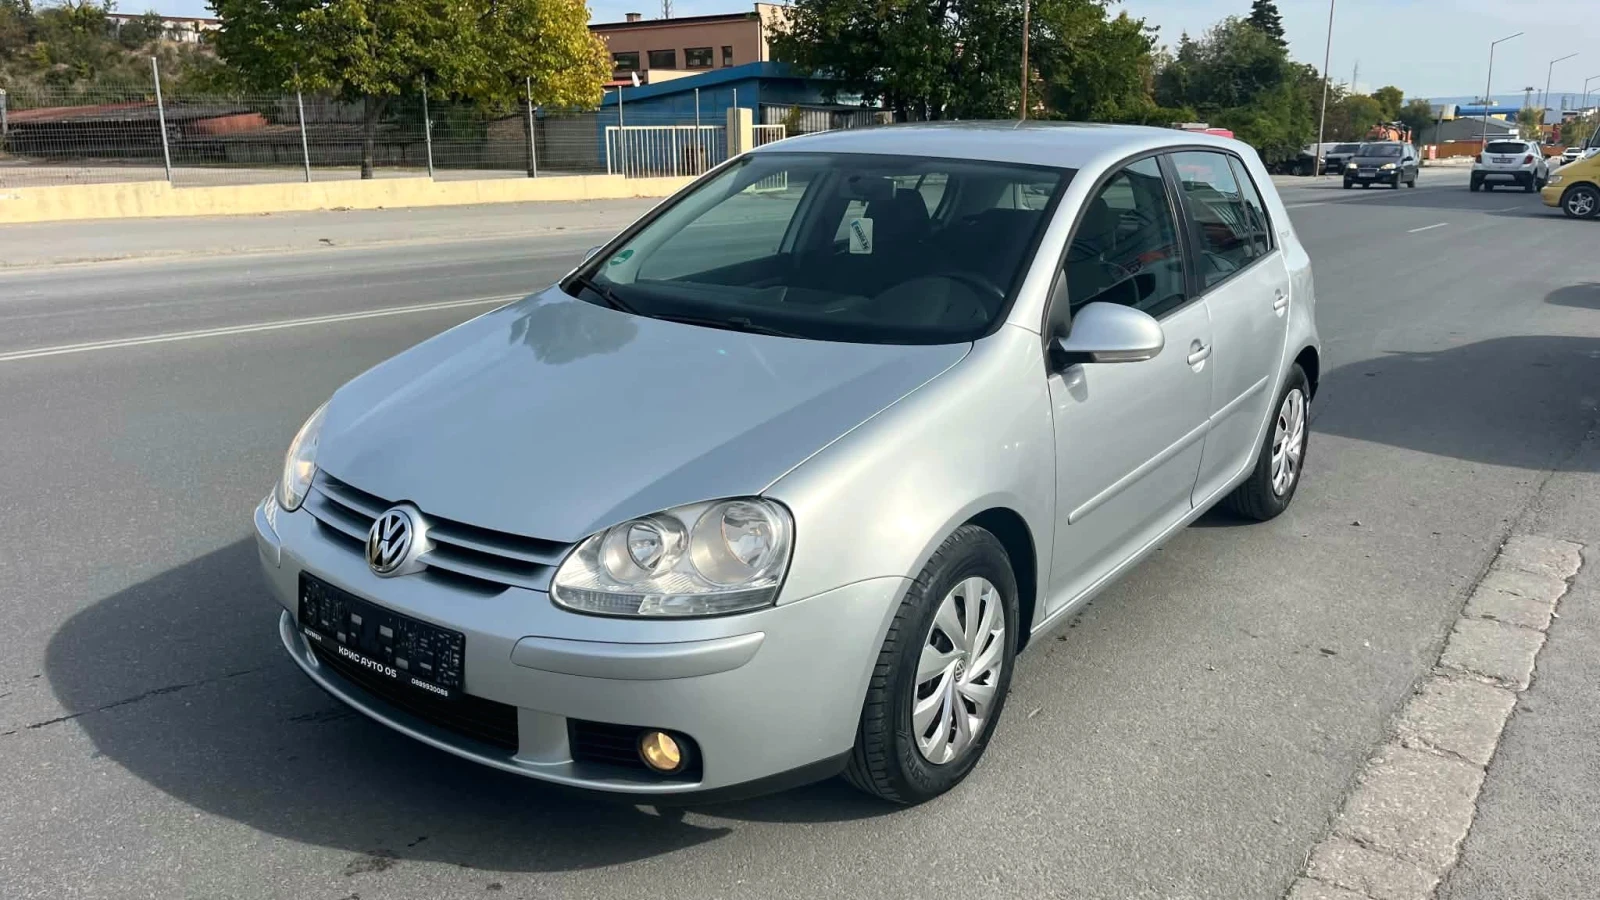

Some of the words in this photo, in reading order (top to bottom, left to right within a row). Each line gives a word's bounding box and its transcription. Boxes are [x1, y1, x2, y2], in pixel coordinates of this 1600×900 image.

[338, 646, 360, 663] КРИС
[360, 656, 383, 674] АУТО
[384, 667, 397, 679] 05
